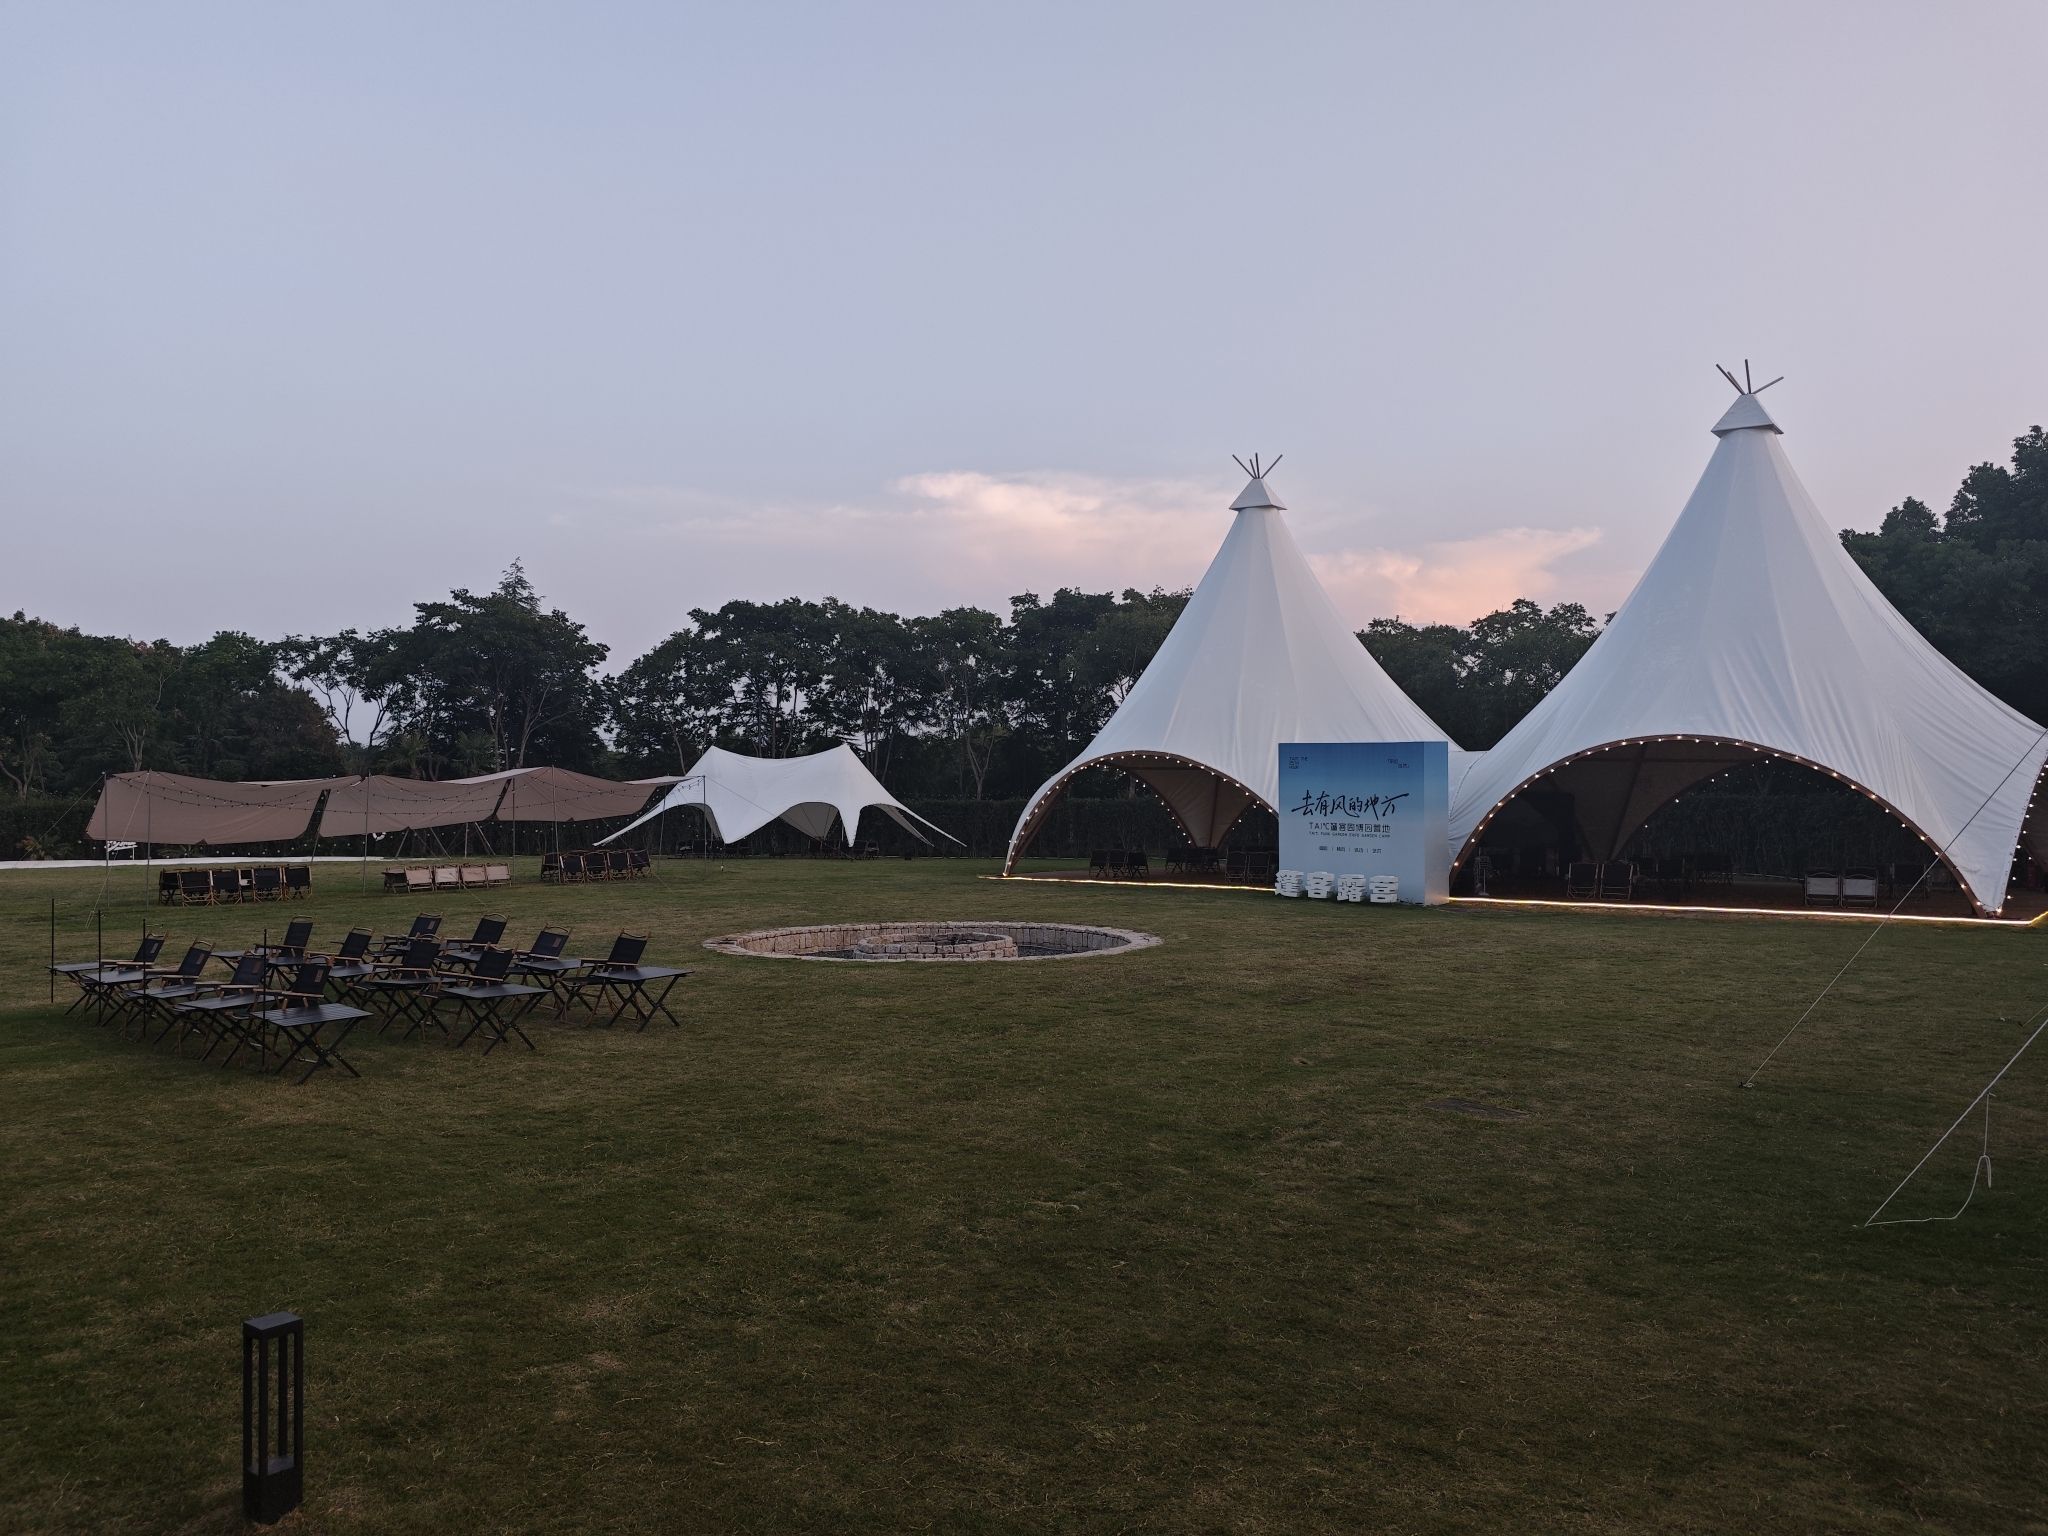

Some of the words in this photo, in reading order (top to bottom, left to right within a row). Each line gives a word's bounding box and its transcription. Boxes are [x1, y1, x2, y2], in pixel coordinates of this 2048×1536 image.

[1291, 789, 1410, 821] 去有风的地方
